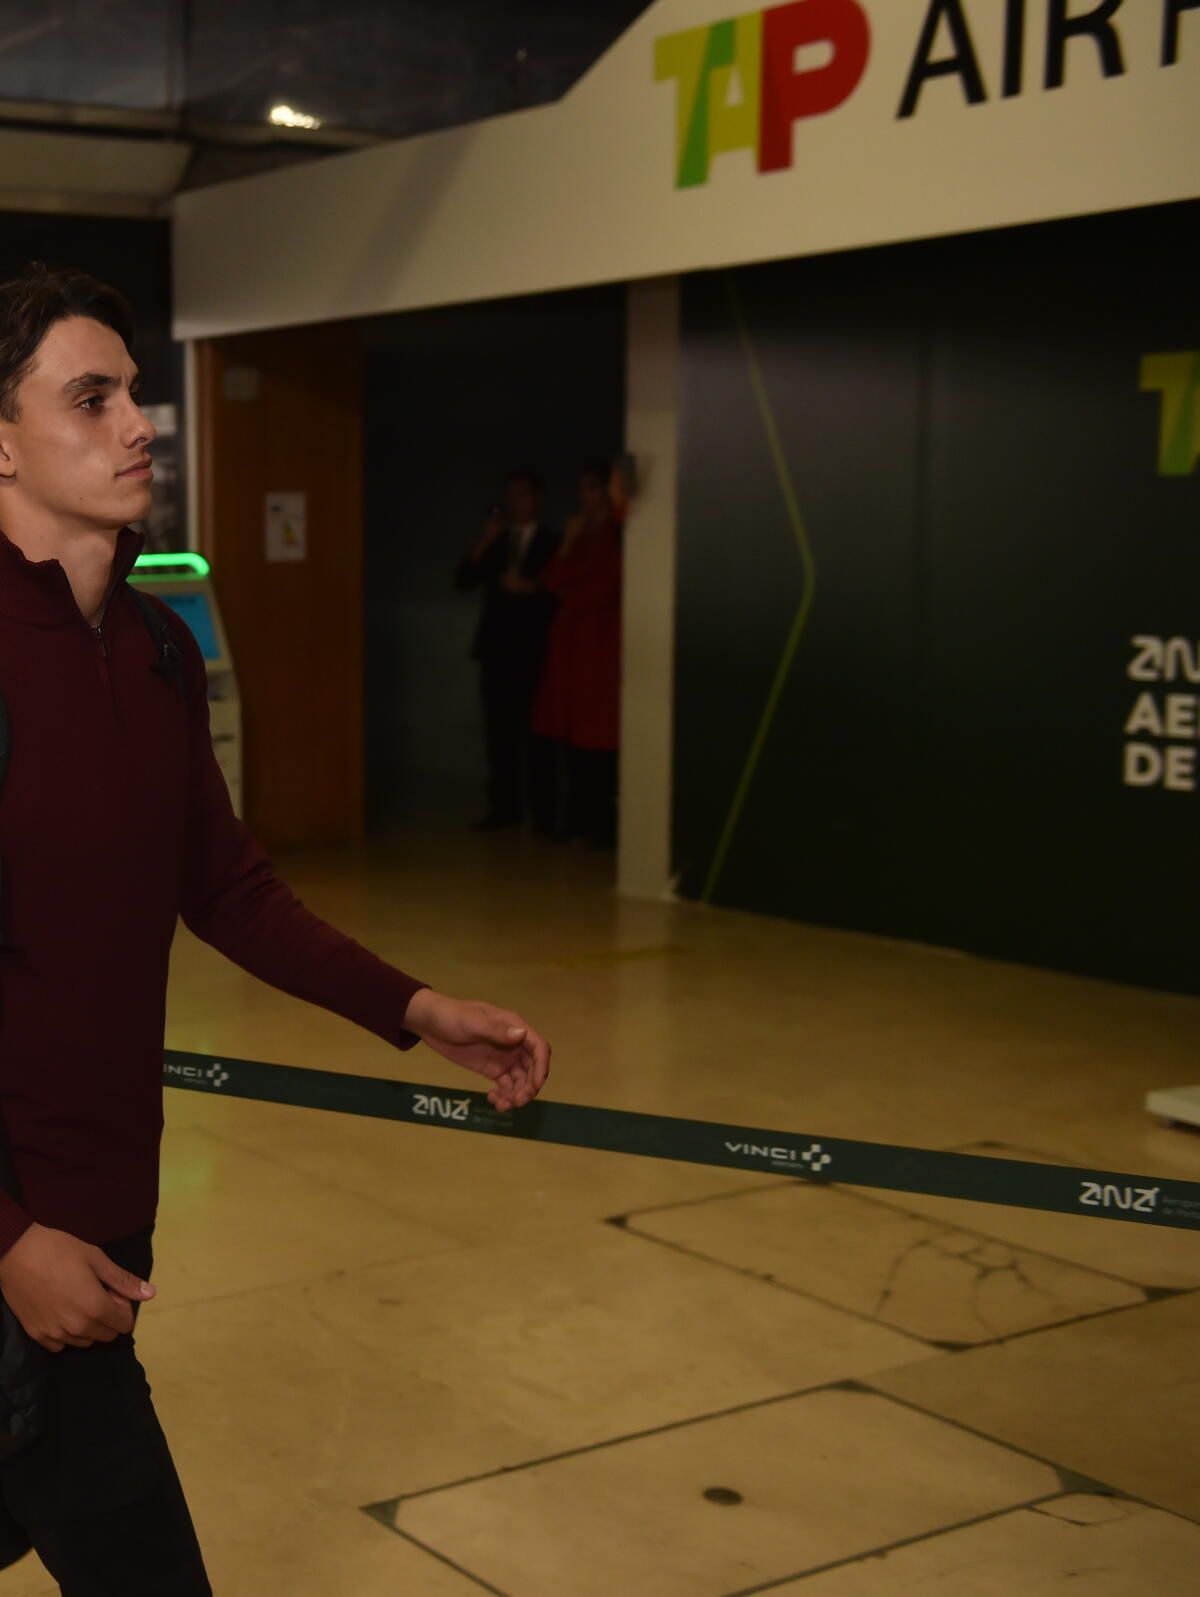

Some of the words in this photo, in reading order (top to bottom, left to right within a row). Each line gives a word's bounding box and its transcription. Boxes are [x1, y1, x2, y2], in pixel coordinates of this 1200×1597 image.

[654, 0, 870, 190] TAP
[896, 0, 1124, 119] AIR
[1123, 691, 1200, 739] AE
[1122, 741, 1198, 793] DE
[163, 1063, 203, 1079] INCI
[724, 1141, 797, 1161] VINCI
